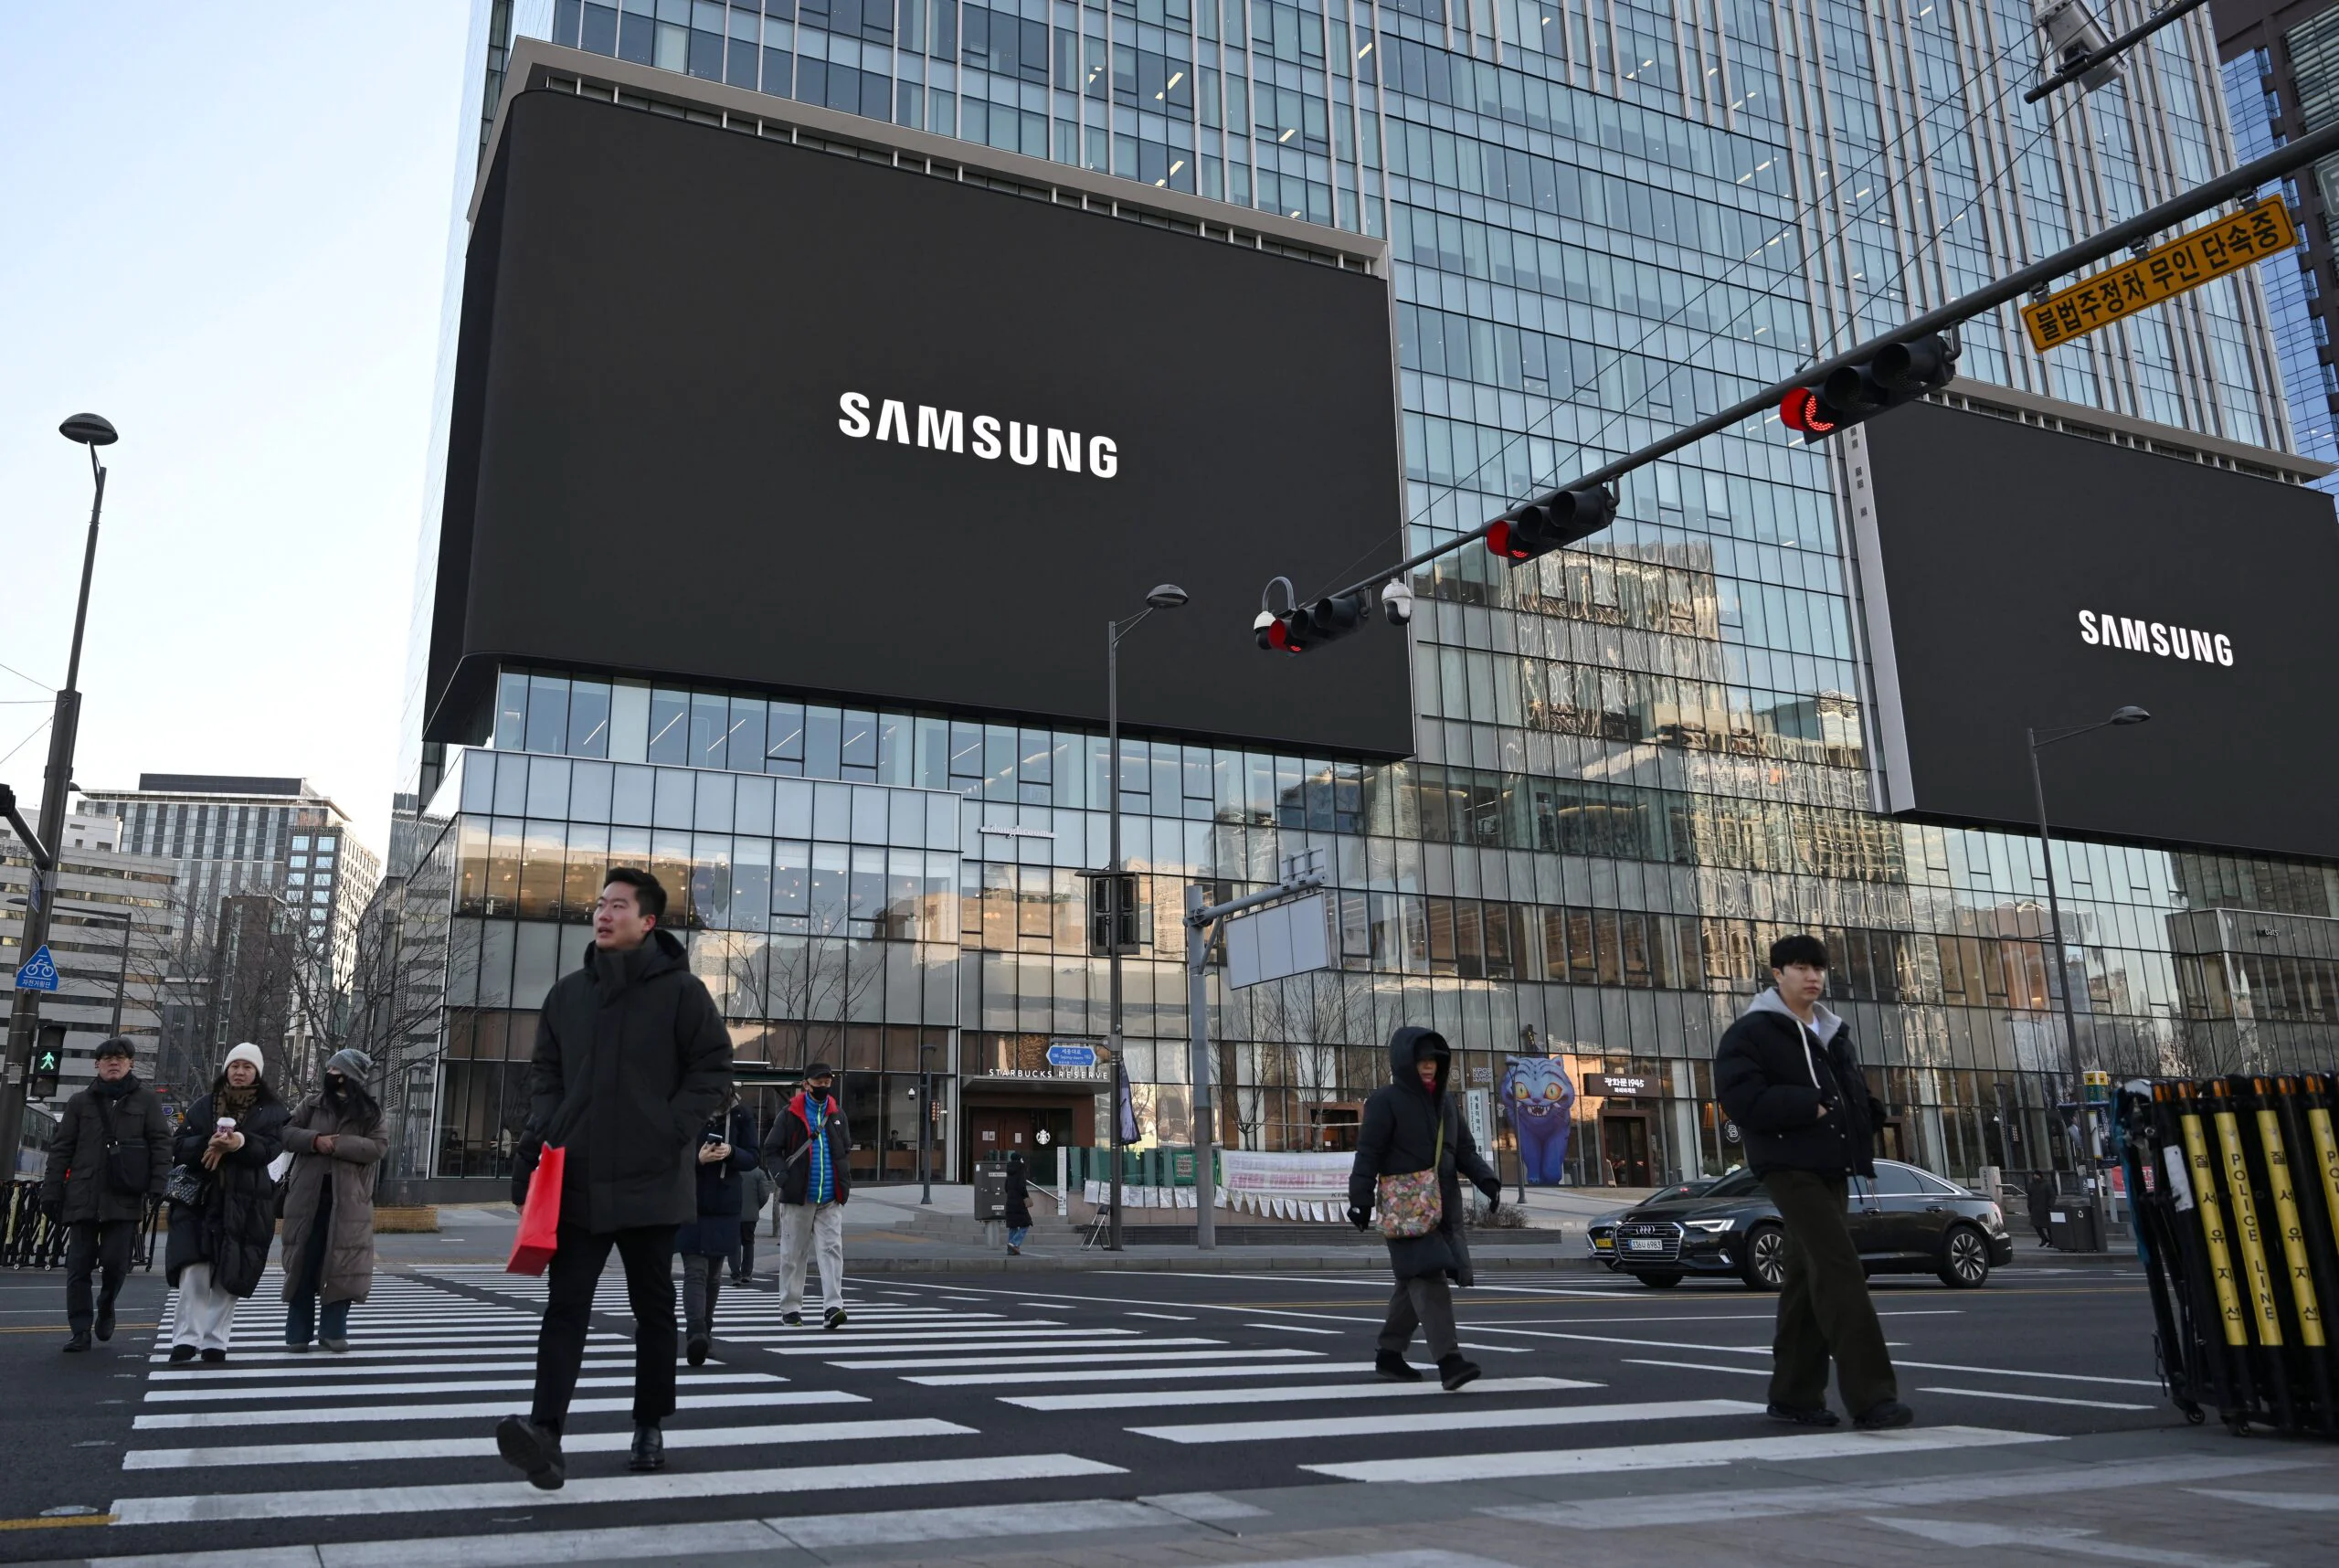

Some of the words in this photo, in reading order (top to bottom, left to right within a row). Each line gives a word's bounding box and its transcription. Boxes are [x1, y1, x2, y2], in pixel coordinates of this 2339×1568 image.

[2036, 269, 2148, 343] 불법주정차
[2149, 246, 2201, 291] 무인
[2203, 211, 2279, 270] 단속중
[838, 391, 1117, 479] SAMSUNG
[2078, 609, 2234, 667] SAMSUNG
[22, 979, 56, 989] 자전거횡단
[989, 1068, 1053, 1078] STARBUCKS
[1058, 1071, 1108, 1080] RESERVE
[2194, 1154, 2241, 1321] 질서유지선
[2230, 1152, 2259, 1243] POLICE
[2254, 1259, 2276, 1320] LINE
[2270, 1150, 2319, 1321] 질서유지선
